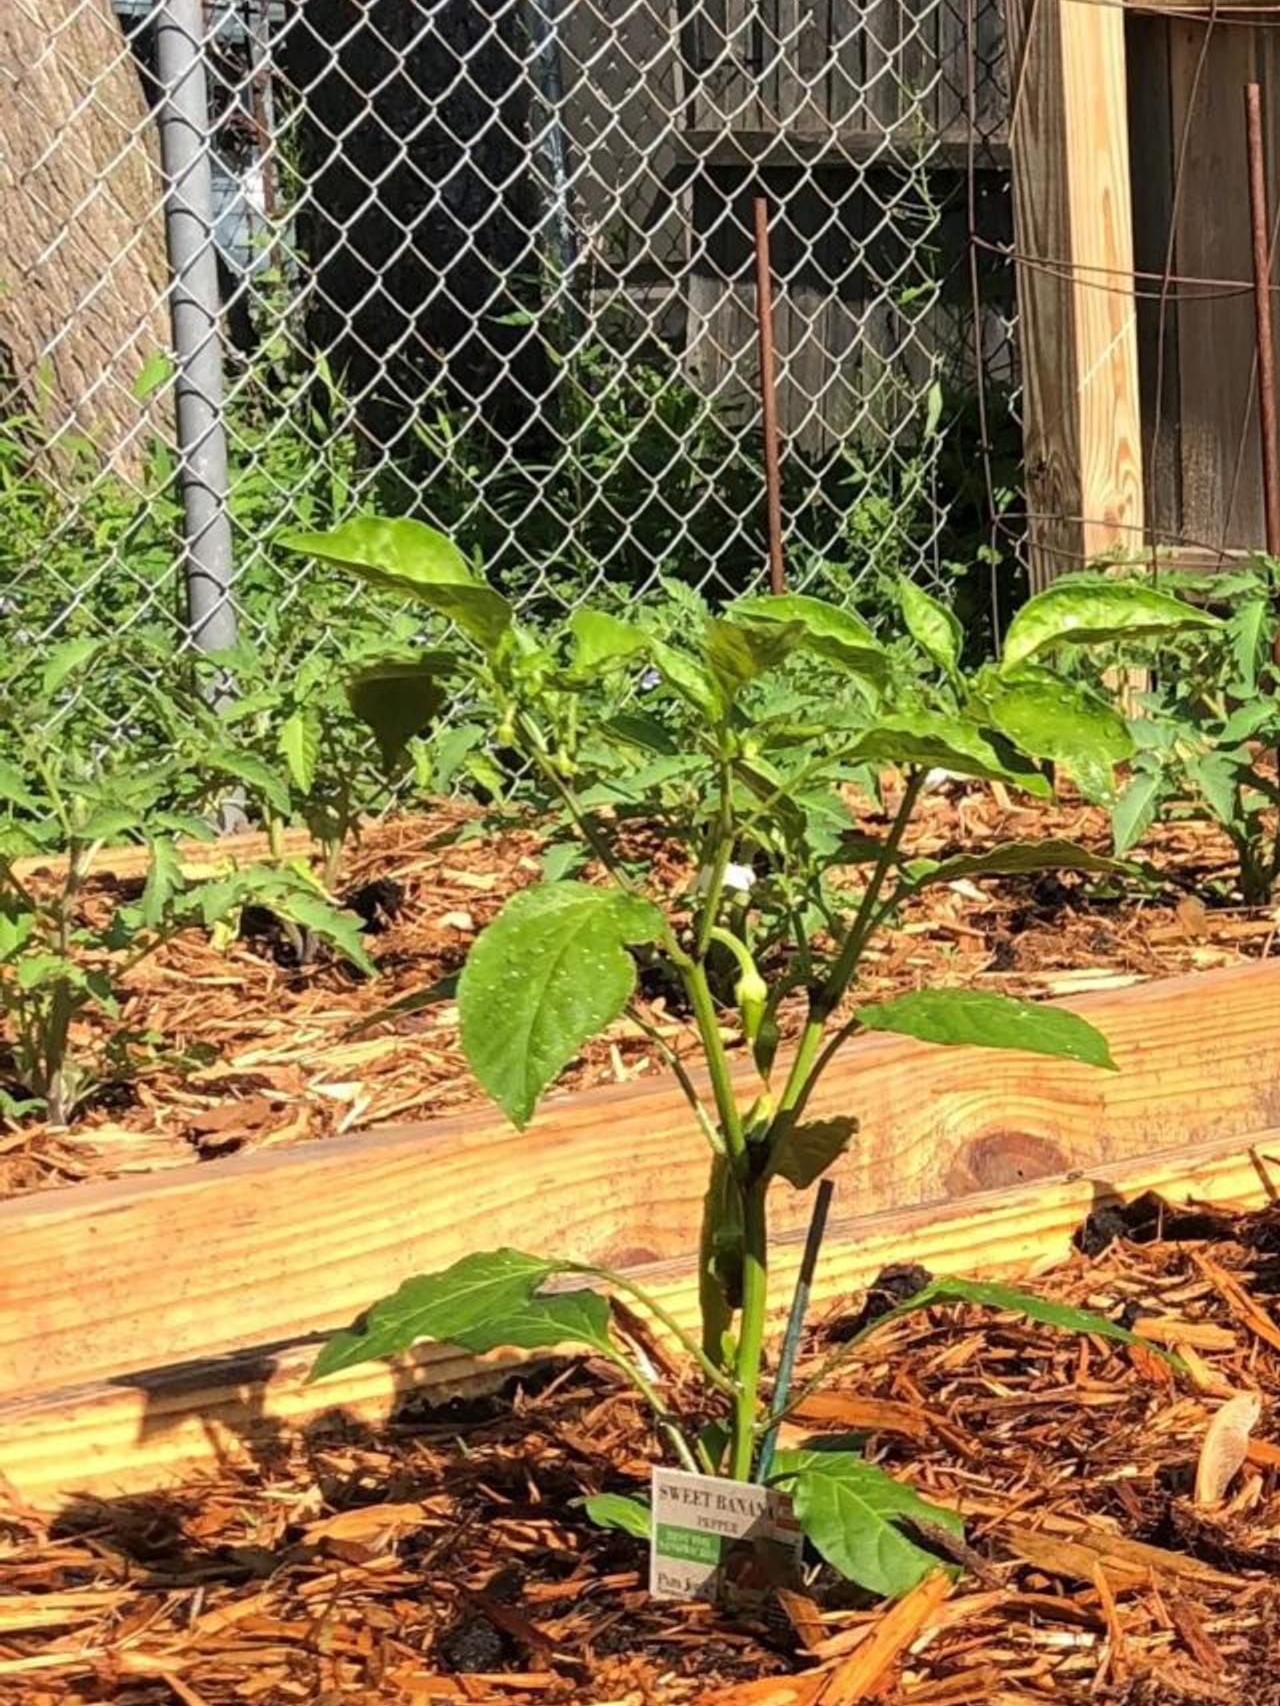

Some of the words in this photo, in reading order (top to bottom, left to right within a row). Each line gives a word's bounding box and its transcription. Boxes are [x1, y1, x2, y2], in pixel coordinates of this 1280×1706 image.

[659, 1486, 710, 1508] SWEET
[717, 1495, 774, 1520] BANANA
[698, 1517, 739, 1534] PEPPER
